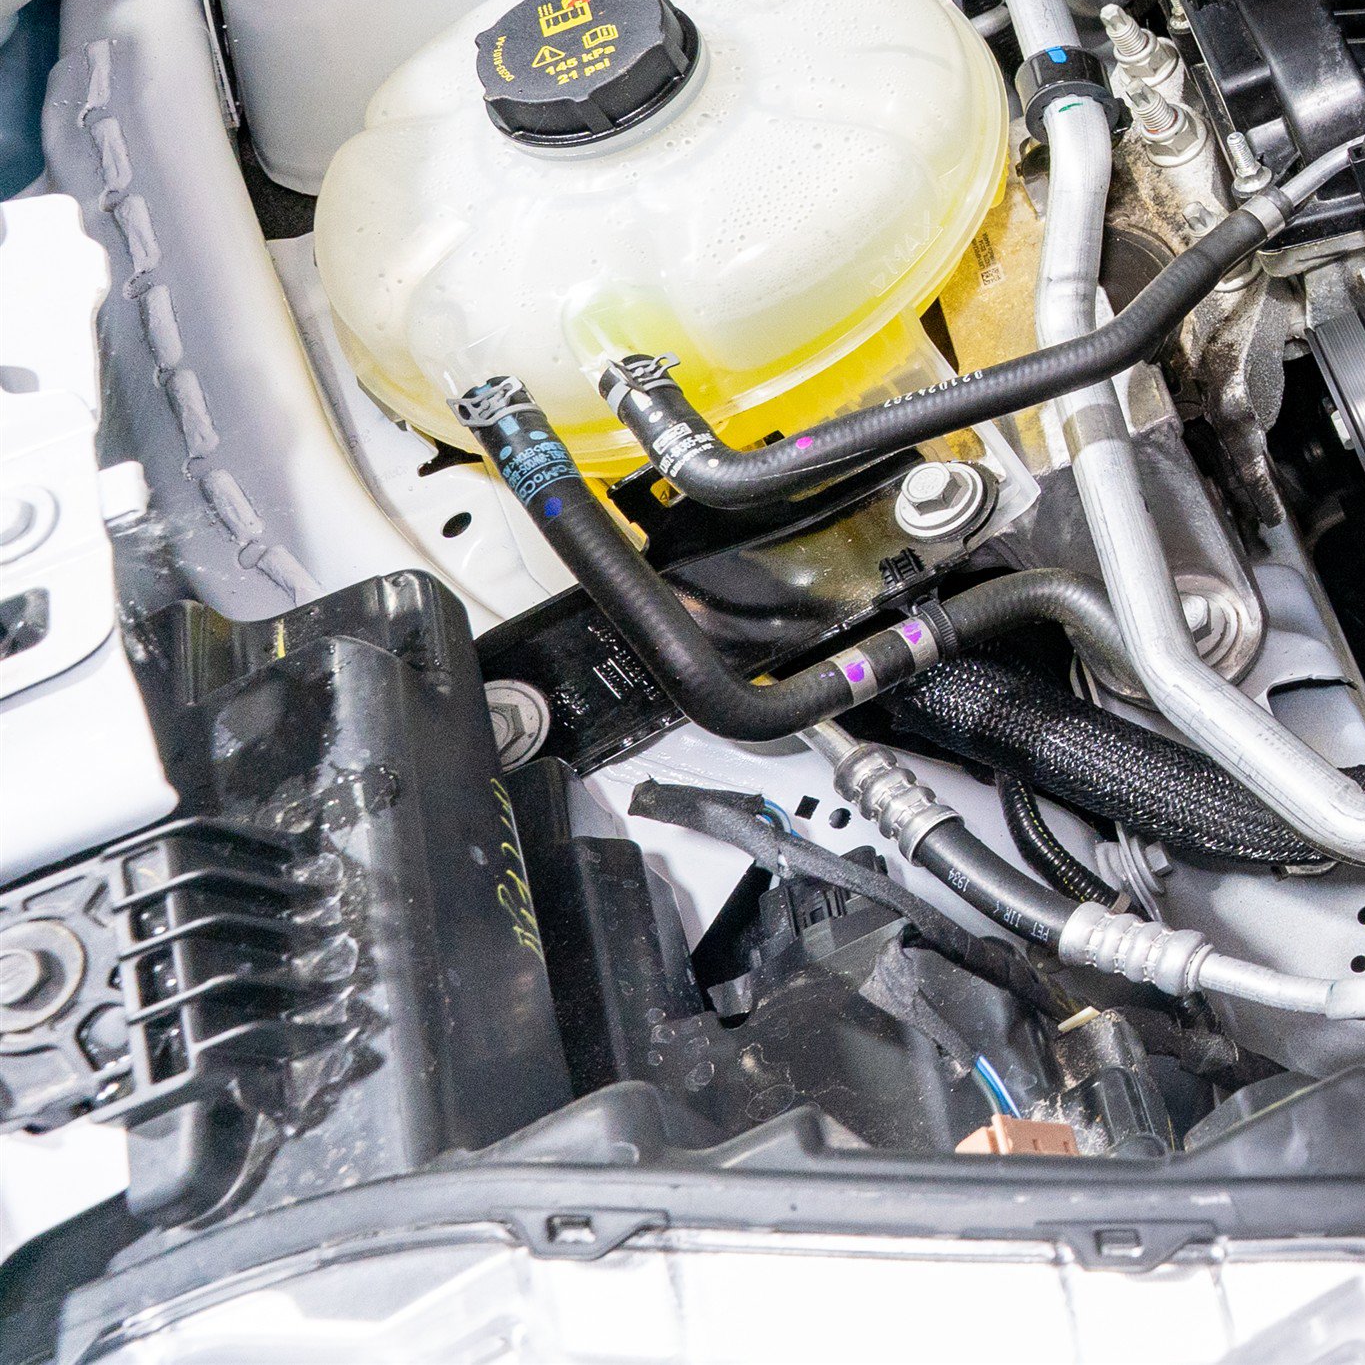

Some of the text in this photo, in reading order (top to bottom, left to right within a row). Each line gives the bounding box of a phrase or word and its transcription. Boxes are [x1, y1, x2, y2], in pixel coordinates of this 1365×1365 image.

[545, 44, 616, 76] 145 kPa
[556, 58, 611, 86] 21 psi
